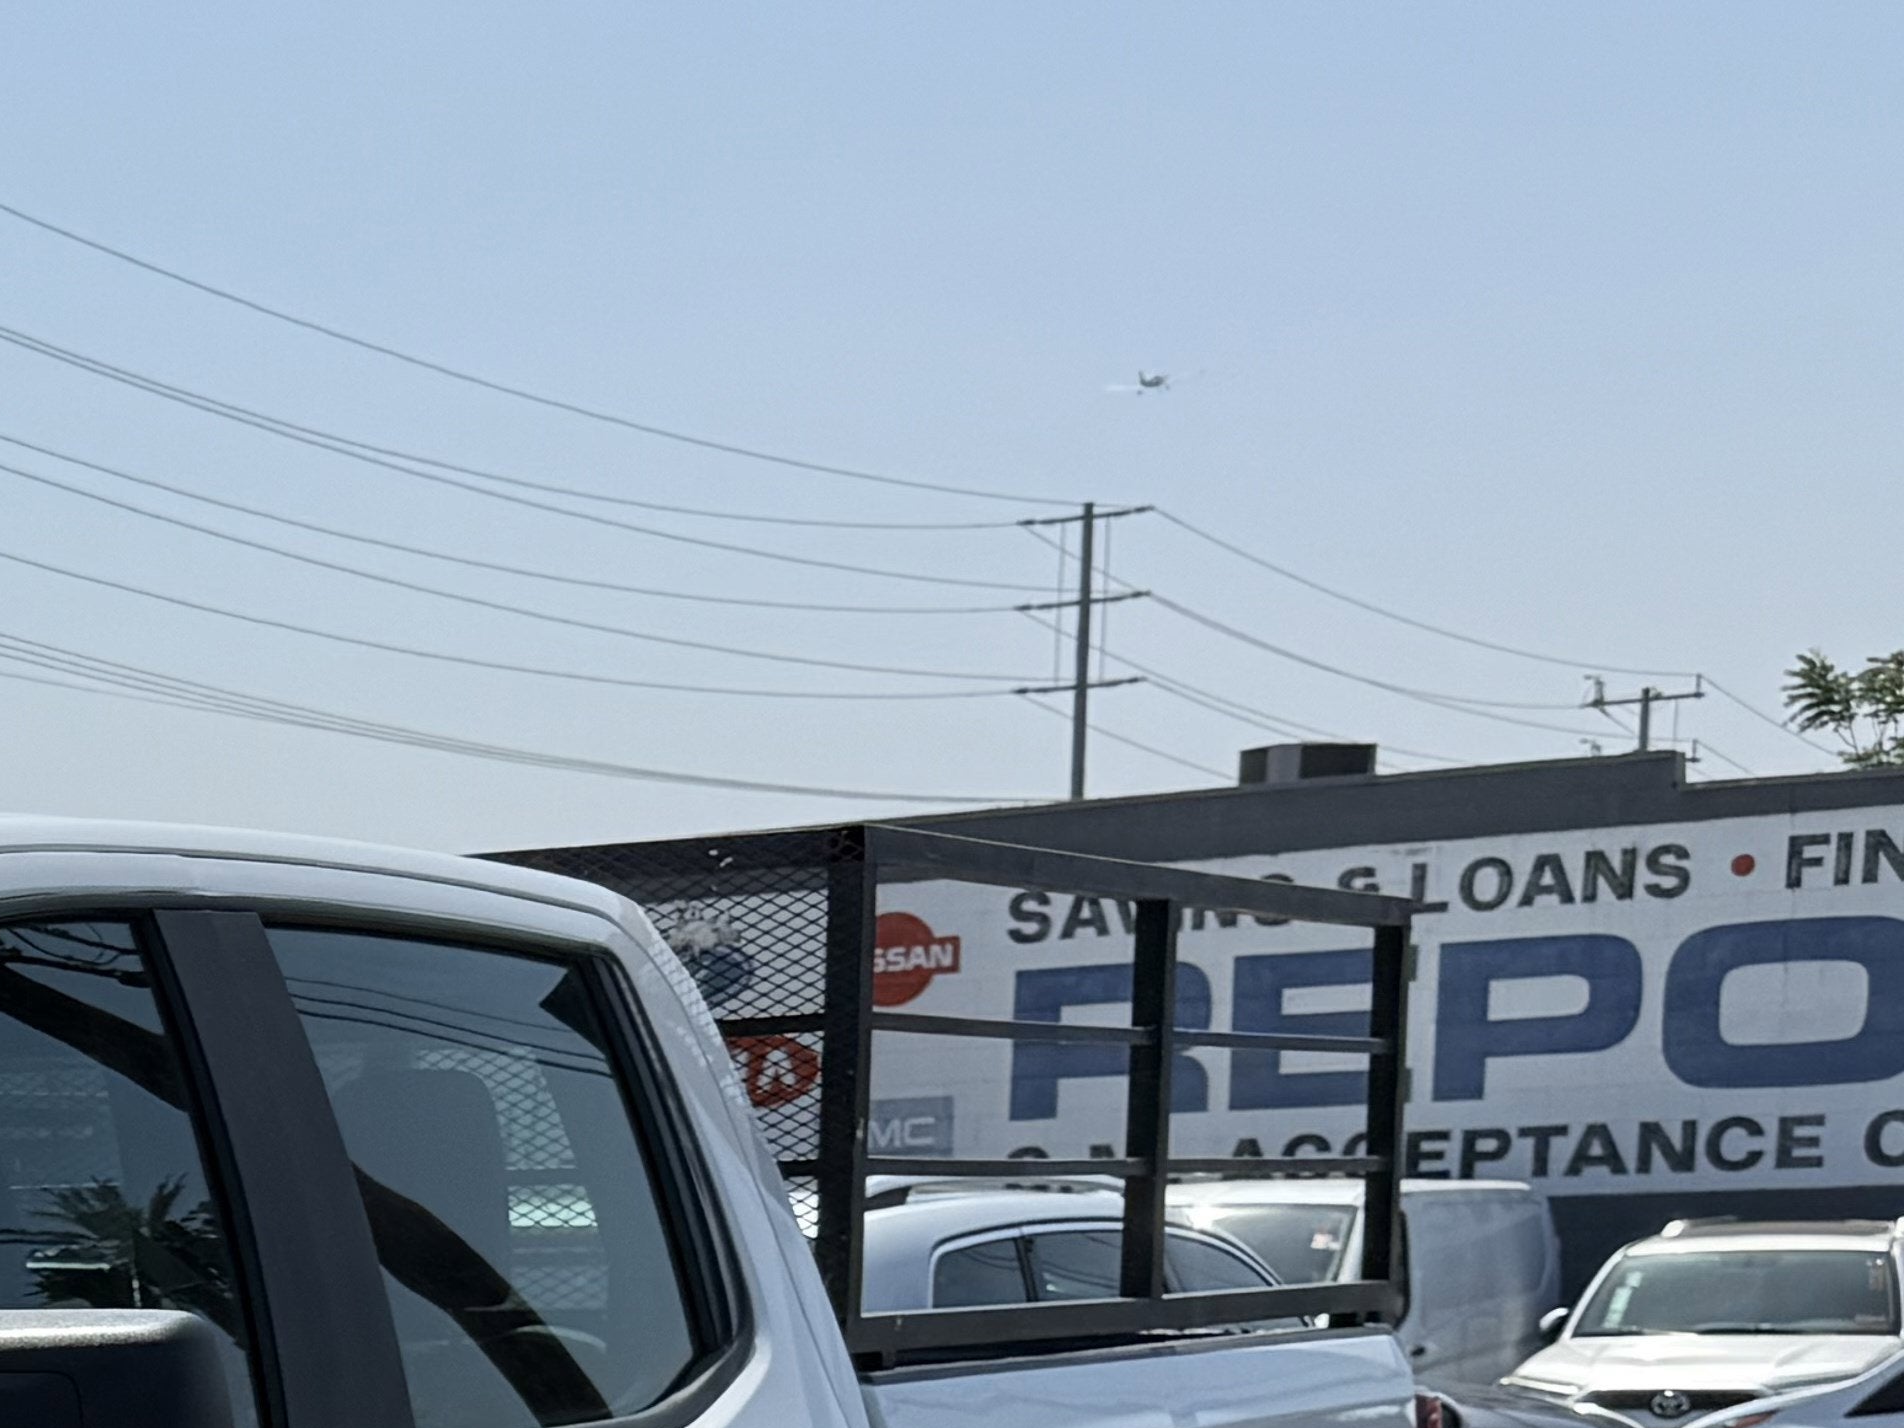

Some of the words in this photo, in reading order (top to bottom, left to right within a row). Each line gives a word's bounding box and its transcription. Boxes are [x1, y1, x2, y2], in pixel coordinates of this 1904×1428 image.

[1408, 843, 1691, 915] LOANS
[873, 943, 954, 974] SSAN
[1008, 915, 1904, 1122] REPO
[868, 1116, 936, 1149] MC
